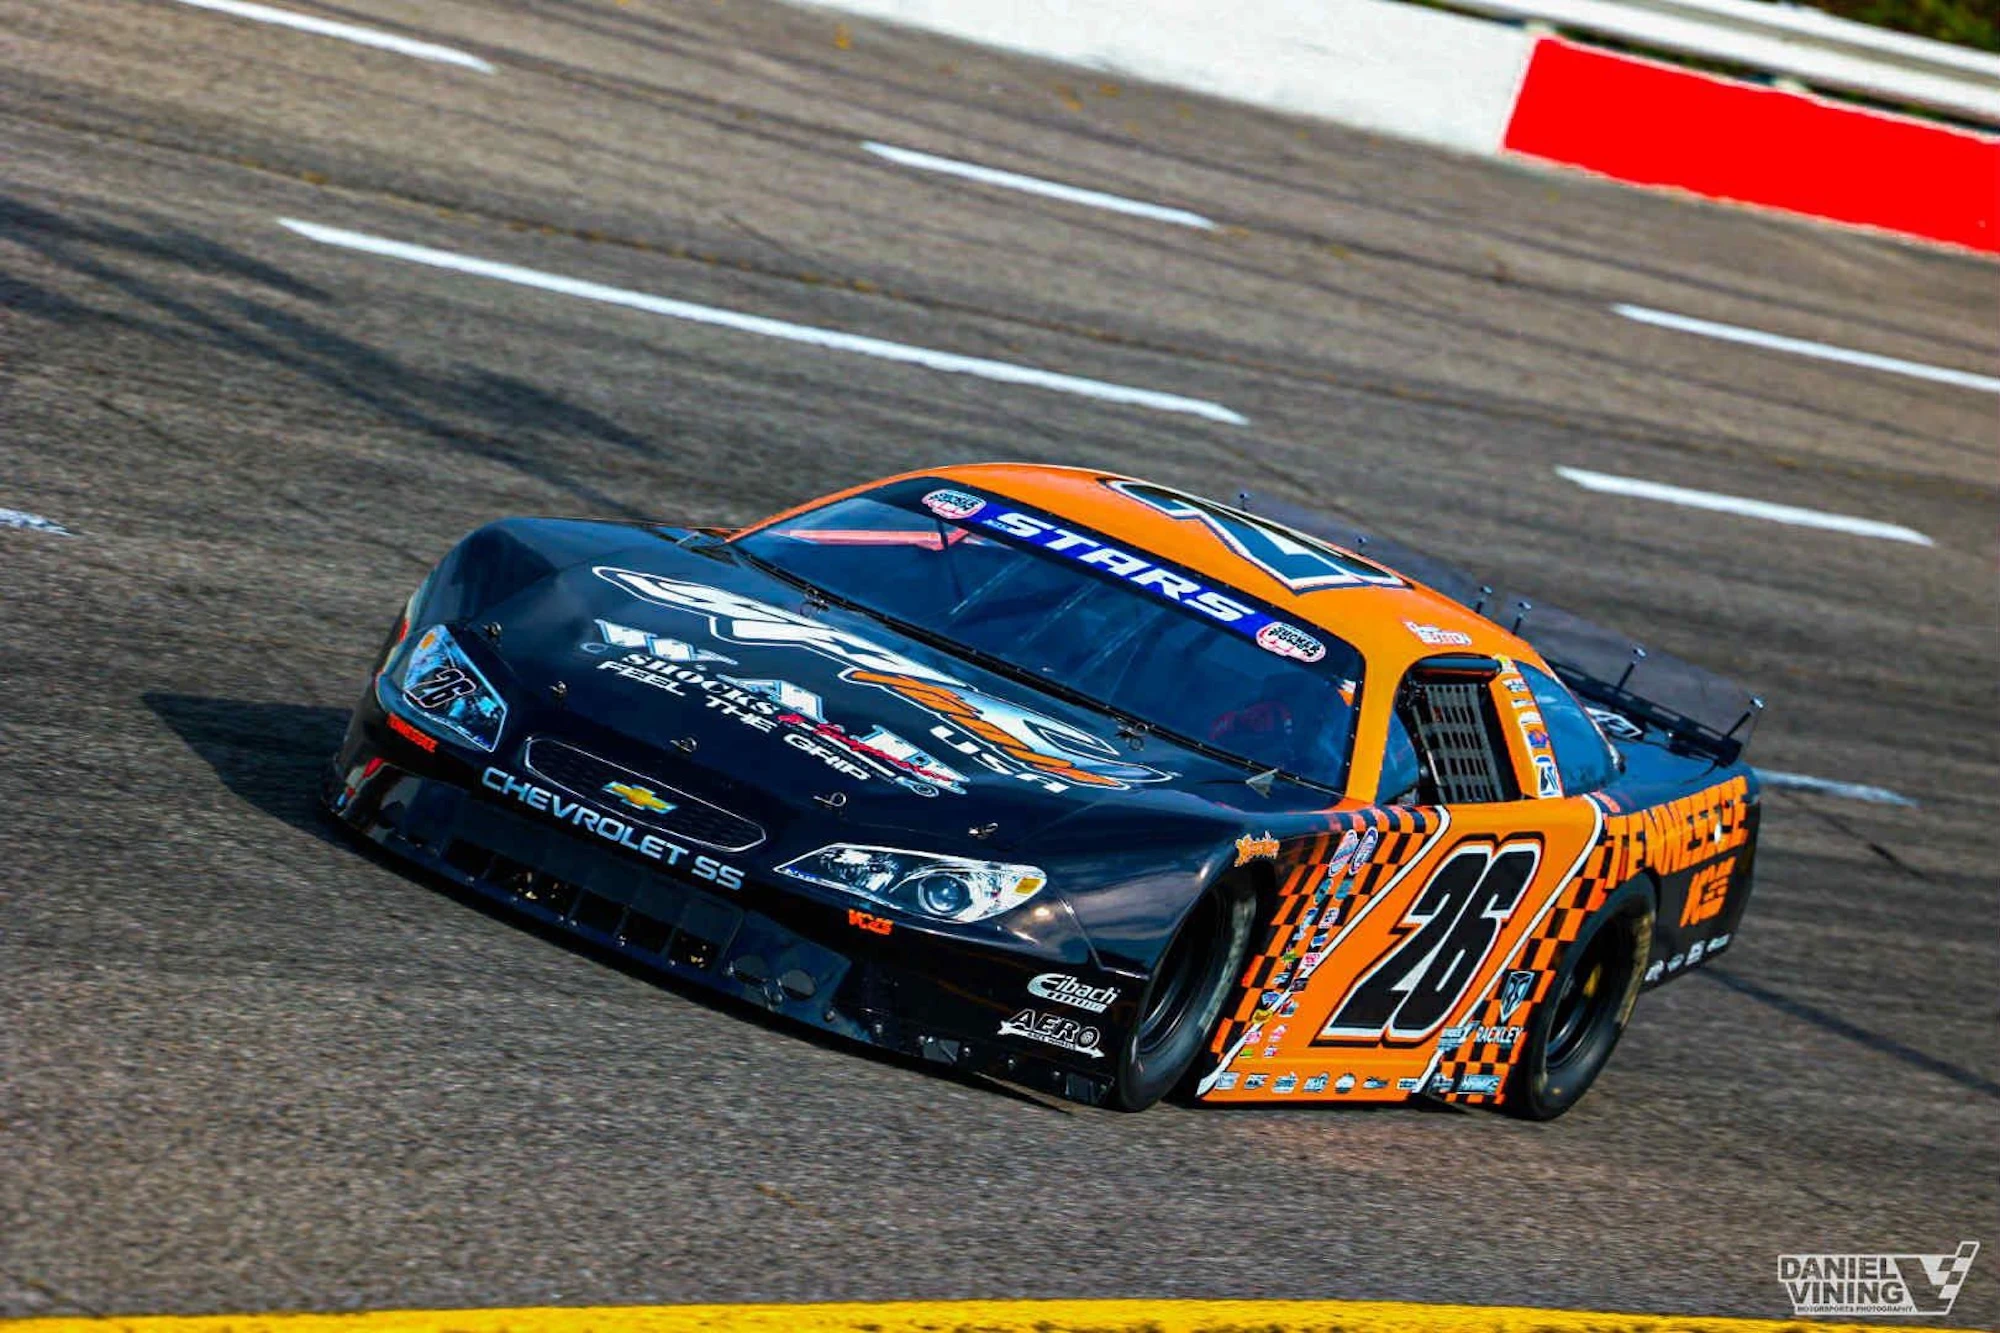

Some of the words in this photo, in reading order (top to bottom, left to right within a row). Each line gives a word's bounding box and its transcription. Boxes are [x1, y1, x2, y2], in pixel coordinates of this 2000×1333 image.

[997, 512, 1256, 622] STARS
[596, 660, 687, 697] FEEL
[704, 694, 779, 734] THE
[783, 732, 872, 781] GRIP
[621, 652, 781, 715] SHOCKS
[929, 724, 1070, 794] USA
[481, 766, 690, 866] CHEVROLET
[691, 855, 746, 890] SS
[1314, 836, 1543, 1046] 26
[1027, 972, 1121, 1006] Eibach
[1475, 1025, 1524, 1044] RACKLEY
